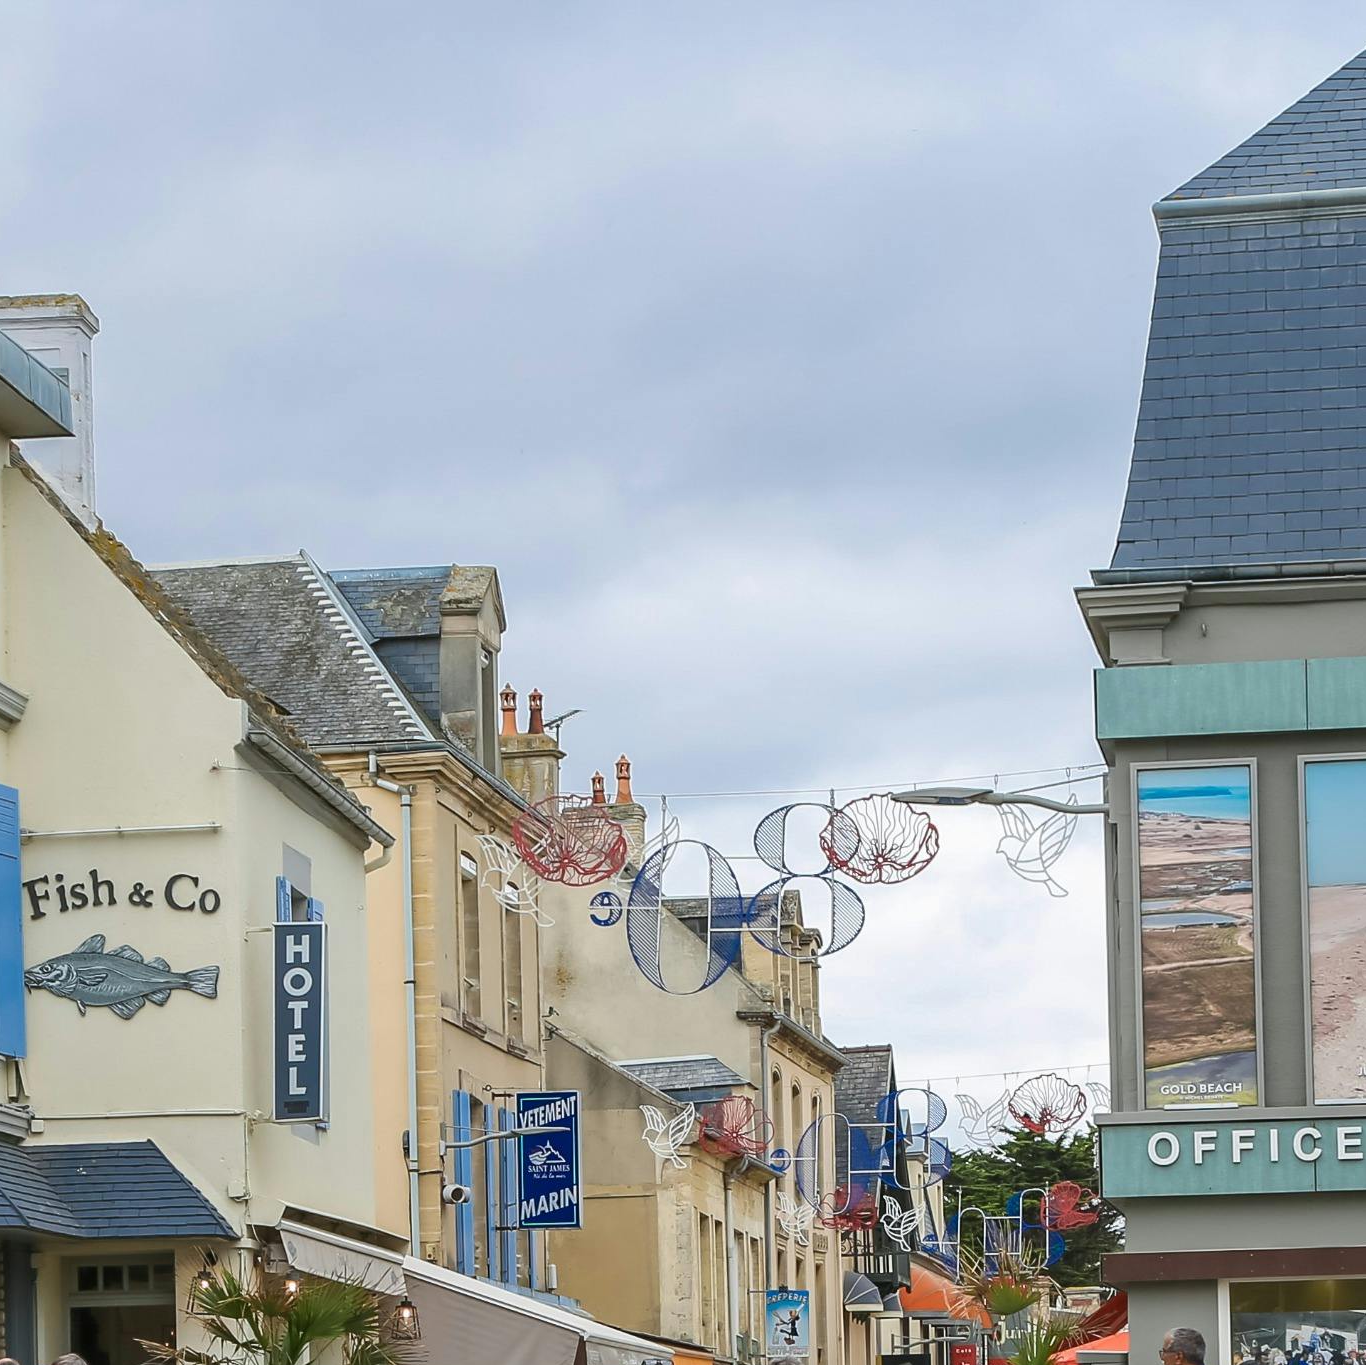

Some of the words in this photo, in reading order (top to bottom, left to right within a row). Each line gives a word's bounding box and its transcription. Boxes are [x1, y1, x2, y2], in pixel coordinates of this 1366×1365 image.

[22, 869, 117, 920] Fish
[128, 882, 154, 908] &
[164, 874, 221, 914] Co
[283, 934, 313, 1096] HOTEL
[1160, 1084, 1196, 1095] GOLD
[1200, 1082, 1242, 1093] BEACH
[519, 1096, 576, 1128] VETEMENT
[1147, 1127, 1365, 1166] OFFICE
[528, 1165, 548, 1173] SAINT
[550, 1164, 570, 1172] JAMES
[521, 1185, 577, 1220] MARIN
